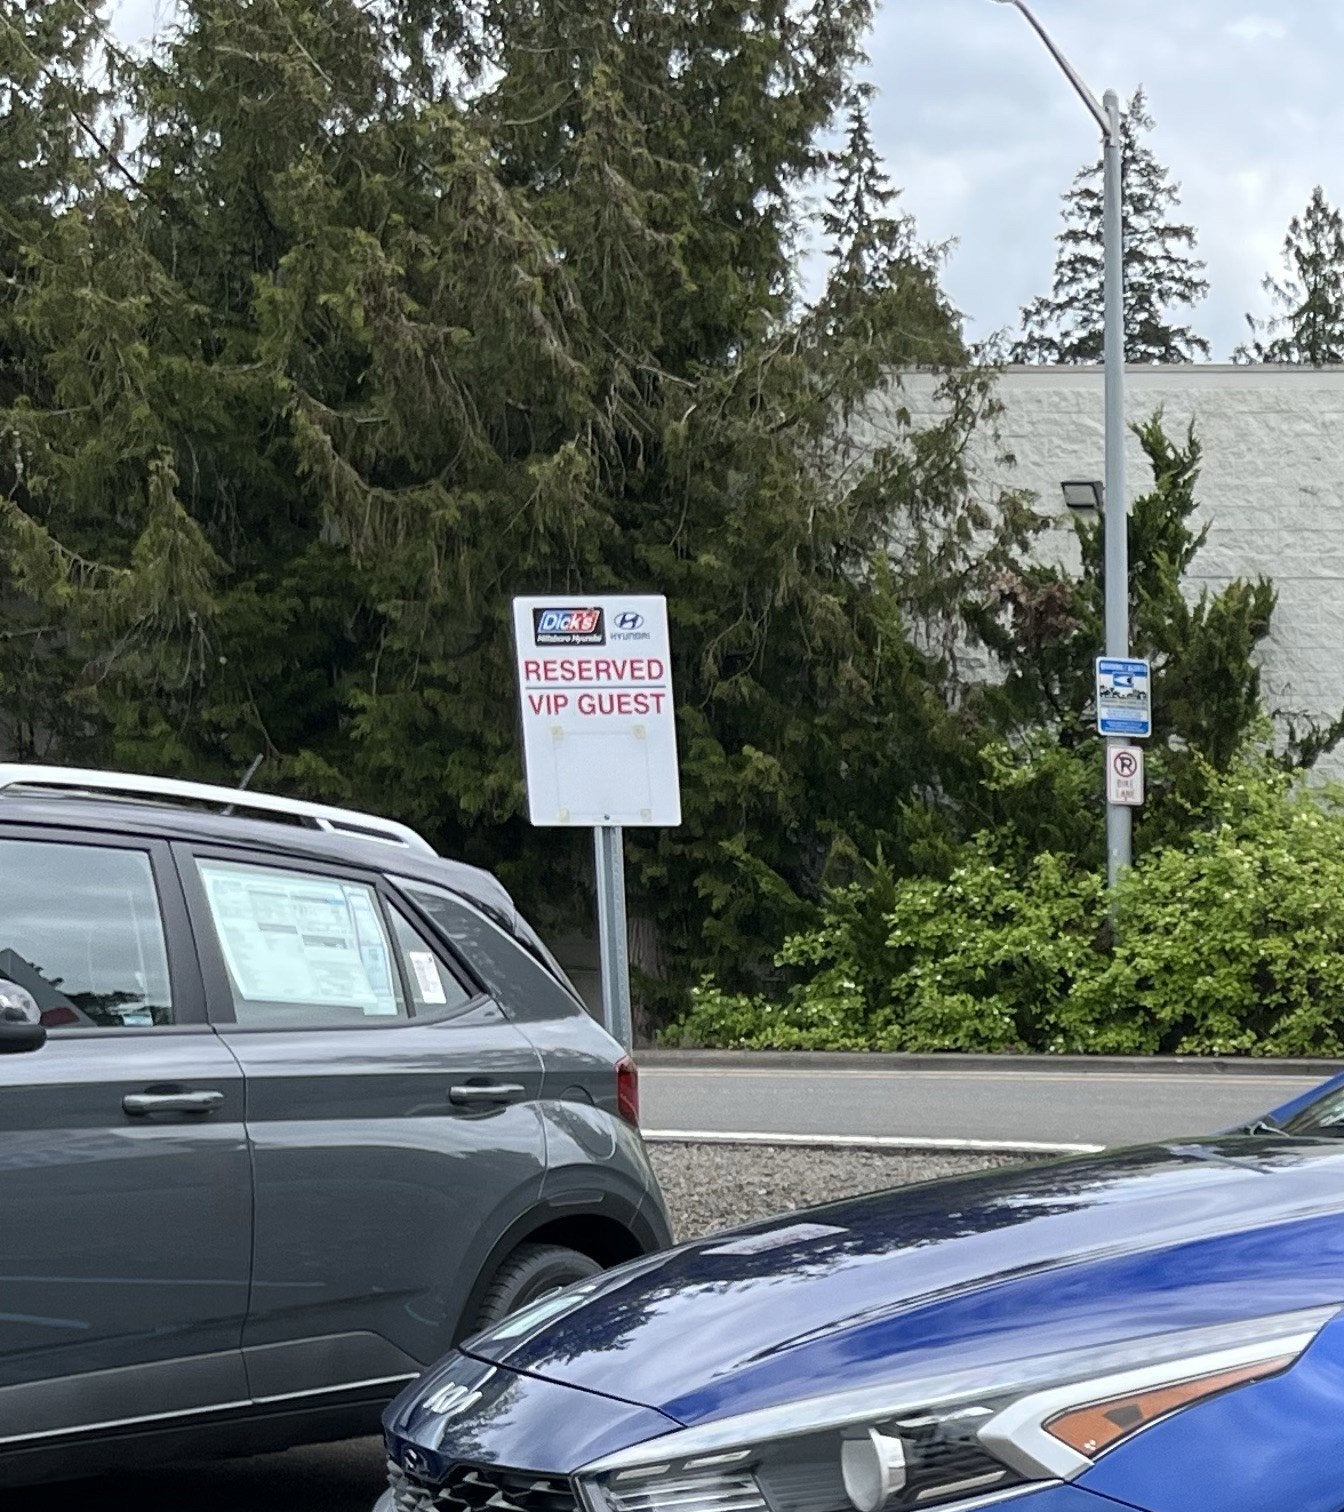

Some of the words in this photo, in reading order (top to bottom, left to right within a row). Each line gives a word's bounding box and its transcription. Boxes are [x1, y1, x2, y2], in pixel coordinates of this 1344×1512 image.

[525, 659, 664, 681] RESERVED
[528, 693, 569, 715] VIP
[578, 692, 666, 715] GUEST
